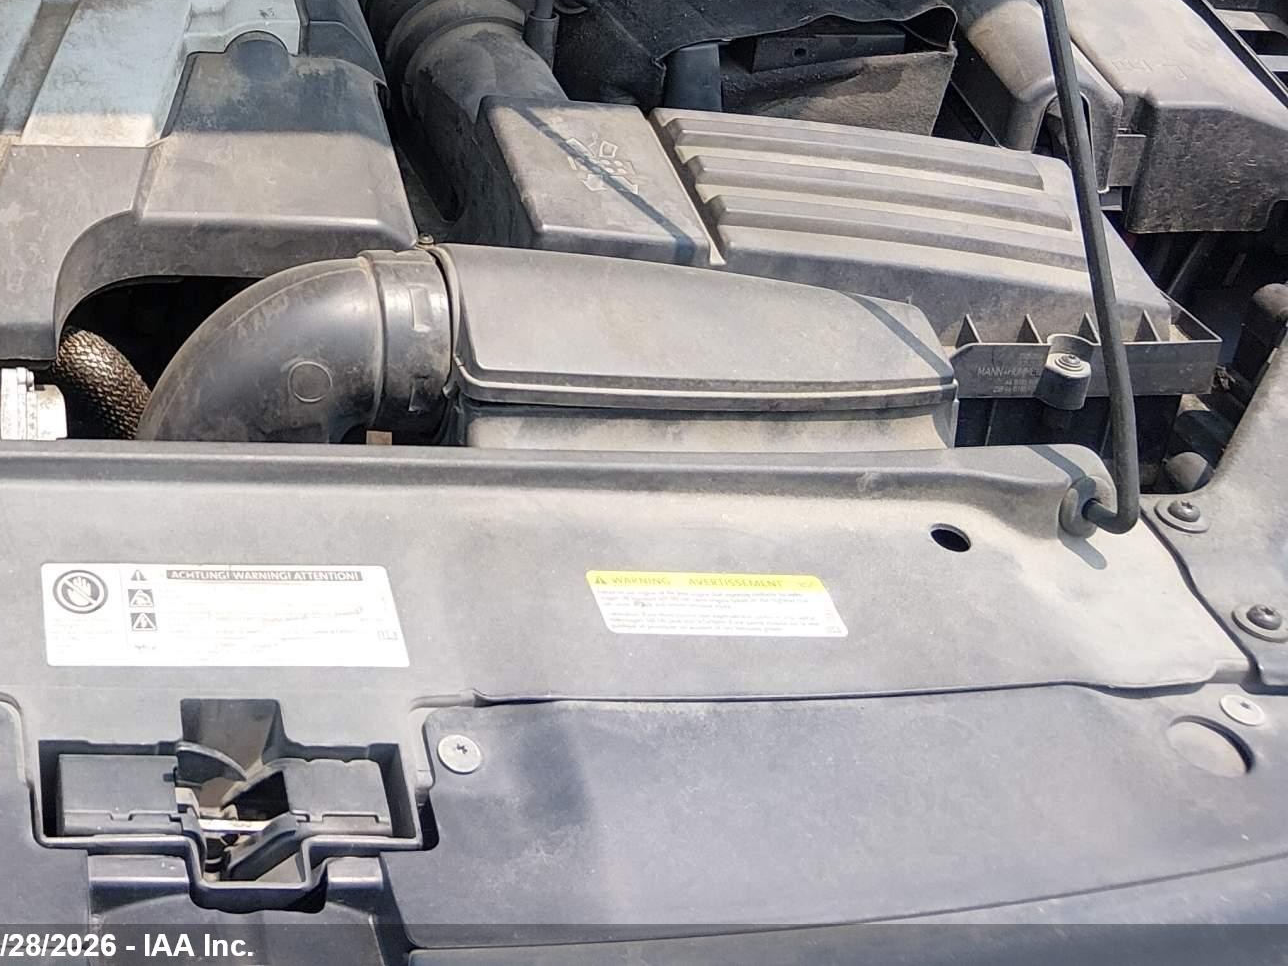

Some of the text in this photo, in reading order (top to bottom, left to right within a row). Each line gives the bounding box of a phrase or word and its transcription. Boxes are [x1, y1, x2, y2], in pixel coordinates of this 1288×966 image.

[170, 569, 360, 582] ACHTUNG! WARNING! ATTENTION!
[611, 576, 671, 586] WARNING
[687, 578, 784, 589] AVERTISSEMENT
